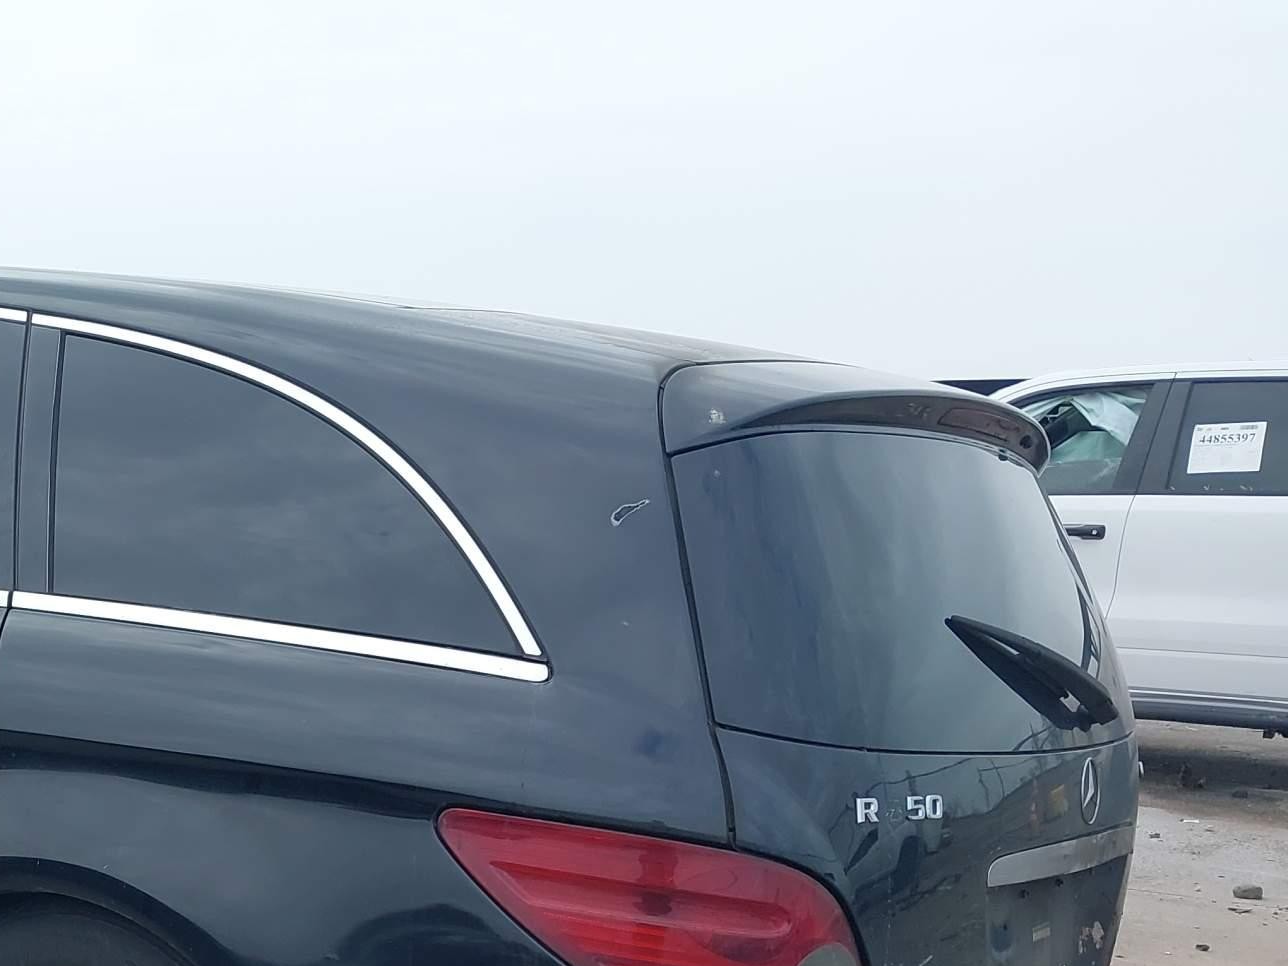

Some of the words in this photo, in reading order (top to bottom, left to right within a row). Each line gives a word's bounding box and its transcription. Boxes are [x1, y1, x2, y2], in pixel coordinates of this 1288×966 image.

[1199, 432, 1257, 444] 44855397
[855, 797, 880, 824] R
[906, 794, 943, 820] 50
